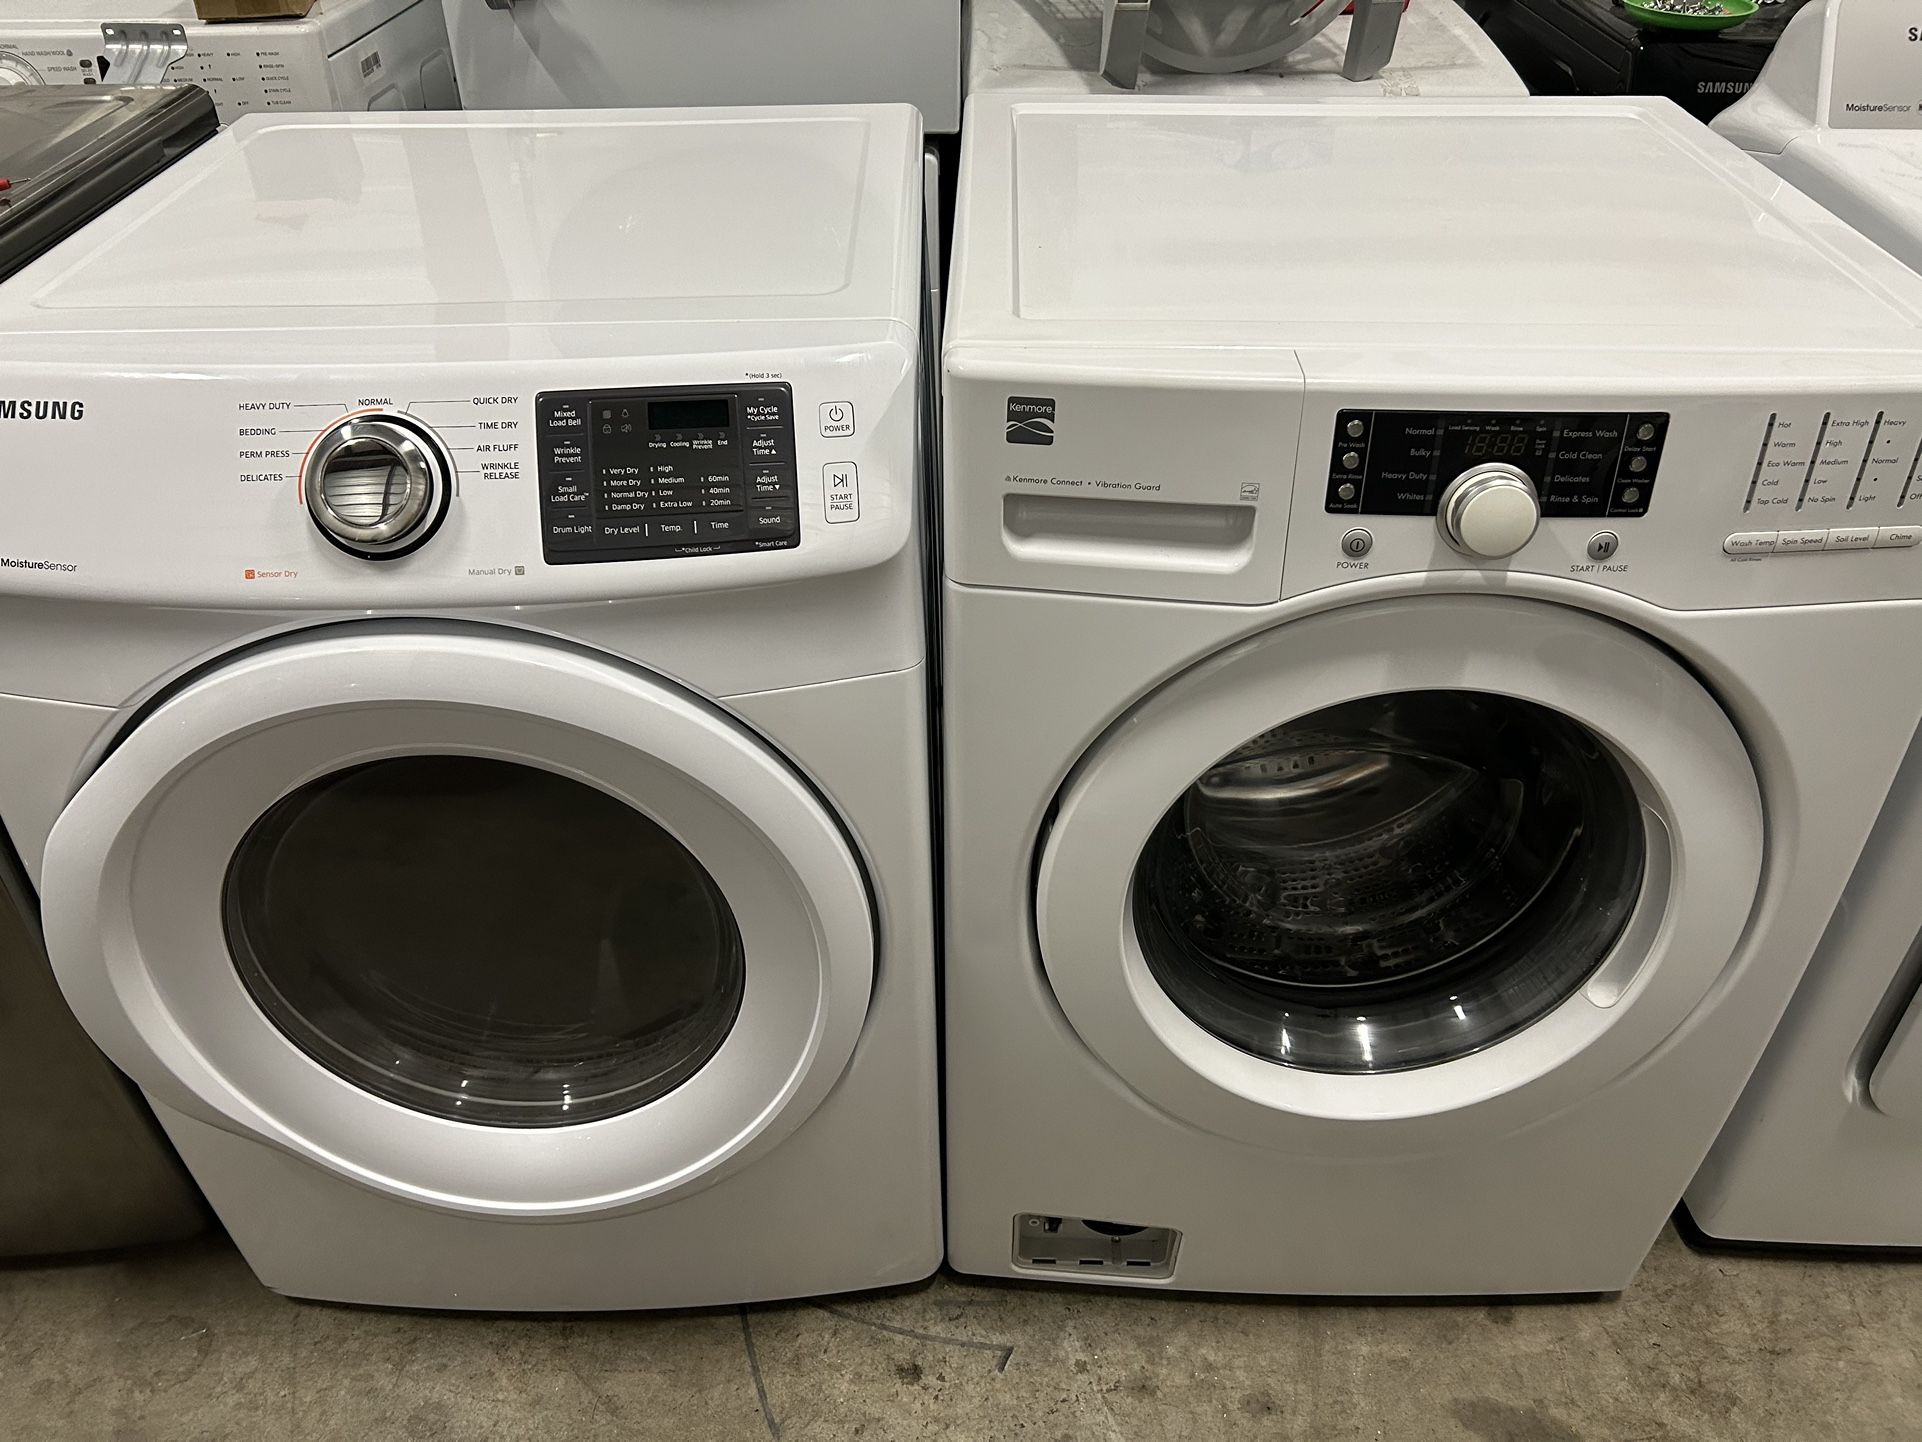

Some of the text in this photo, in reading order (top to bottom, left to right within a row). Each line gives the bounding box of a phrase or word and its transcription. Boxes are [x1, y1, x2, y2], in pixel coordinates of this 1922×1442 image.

[1697, 82, 1752, 94] SAMSUN
[1846, 104, 1911, 112] MoistureSensor
[358, 398, 393, 406] NORMAL
[473, 396, 518, 405] QUICK DRY
[0, 400, 84, 420] MSUNG
[239, 402, 291, 411] HEAVY DUTY
[760, 406, 778, 414] Cycle
[1010, 402, 1052, 413] Kenmore
[493, 444, 519, 452] FLUFF
[752, 439, 774, 448] Adjust
[240, 450, 290, 458] PERM PRESS
[554, 446, 581, 454] Wrinkle
[1410, 449, 1431, 458] Bulky
[481, 462, 519, 470] WRINKLE
[756, 475, 778, 484] Adjust
[1382, 472, 1406, 480] Heavy
[1013, 476, 1082, 486] Kenmore Connect
[1096, 480, 1160, 491] Vibration Guard
[1582, 496, 1598, 504] Spin
[830, 503, 853, 511] PAUSE
[574, 525, 592, 534] Light
[605, 526, 640, 536] Dry Level
[661, 524, 682, 533] Temp.
[1782, 536, 1822, 546] Spin Speed
[1890, 533, 1912, 541] Chime
[1755, 539, 1774, 548] Temp
[0, 558, 77, 572] MoistureSensor
[257, 570, 298, 580] Sensor Dry
[468, 567, 512, 578] Manual Dry
